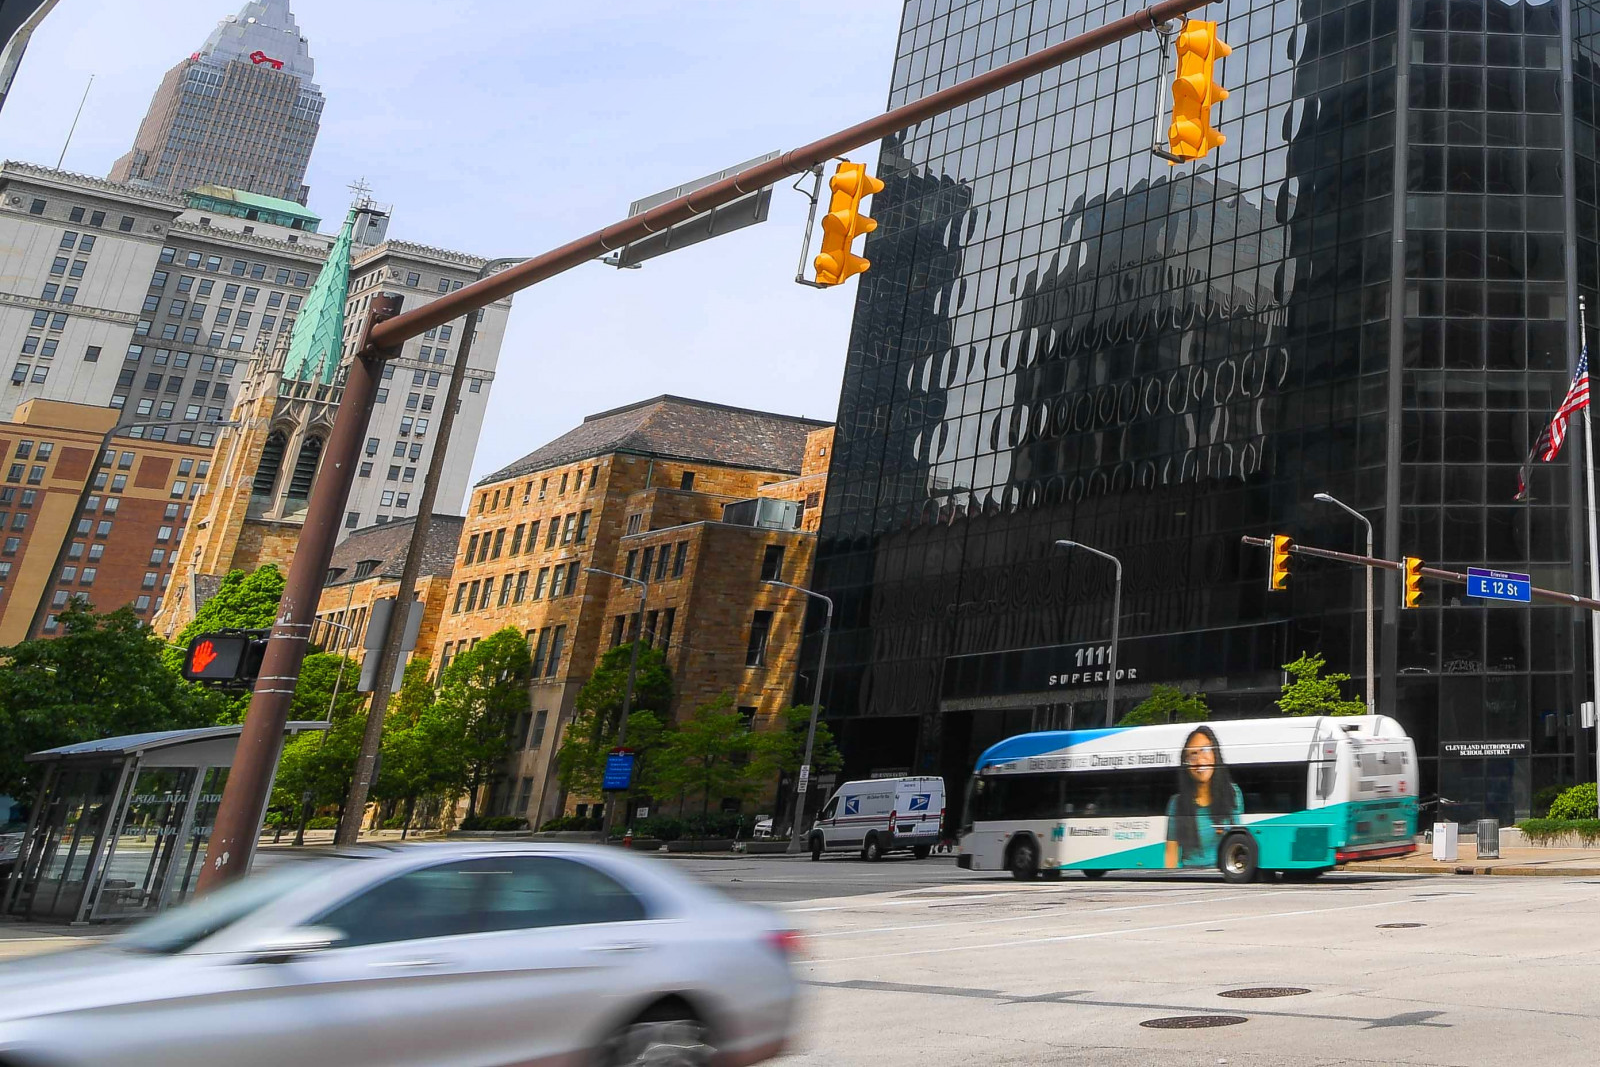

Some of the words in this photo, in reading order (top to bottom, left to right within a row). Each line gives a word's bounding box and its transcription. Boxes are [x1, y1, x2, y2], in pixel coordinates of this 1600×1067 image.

[1481, 580, 1490, 594] E.
[1492, 581, 1504, 595] 12
[1507, 583, 1518, 596] St
[1075, 645, 1112, 667] 1111
[1048, 668, 1137, 686] SUPERIOR
